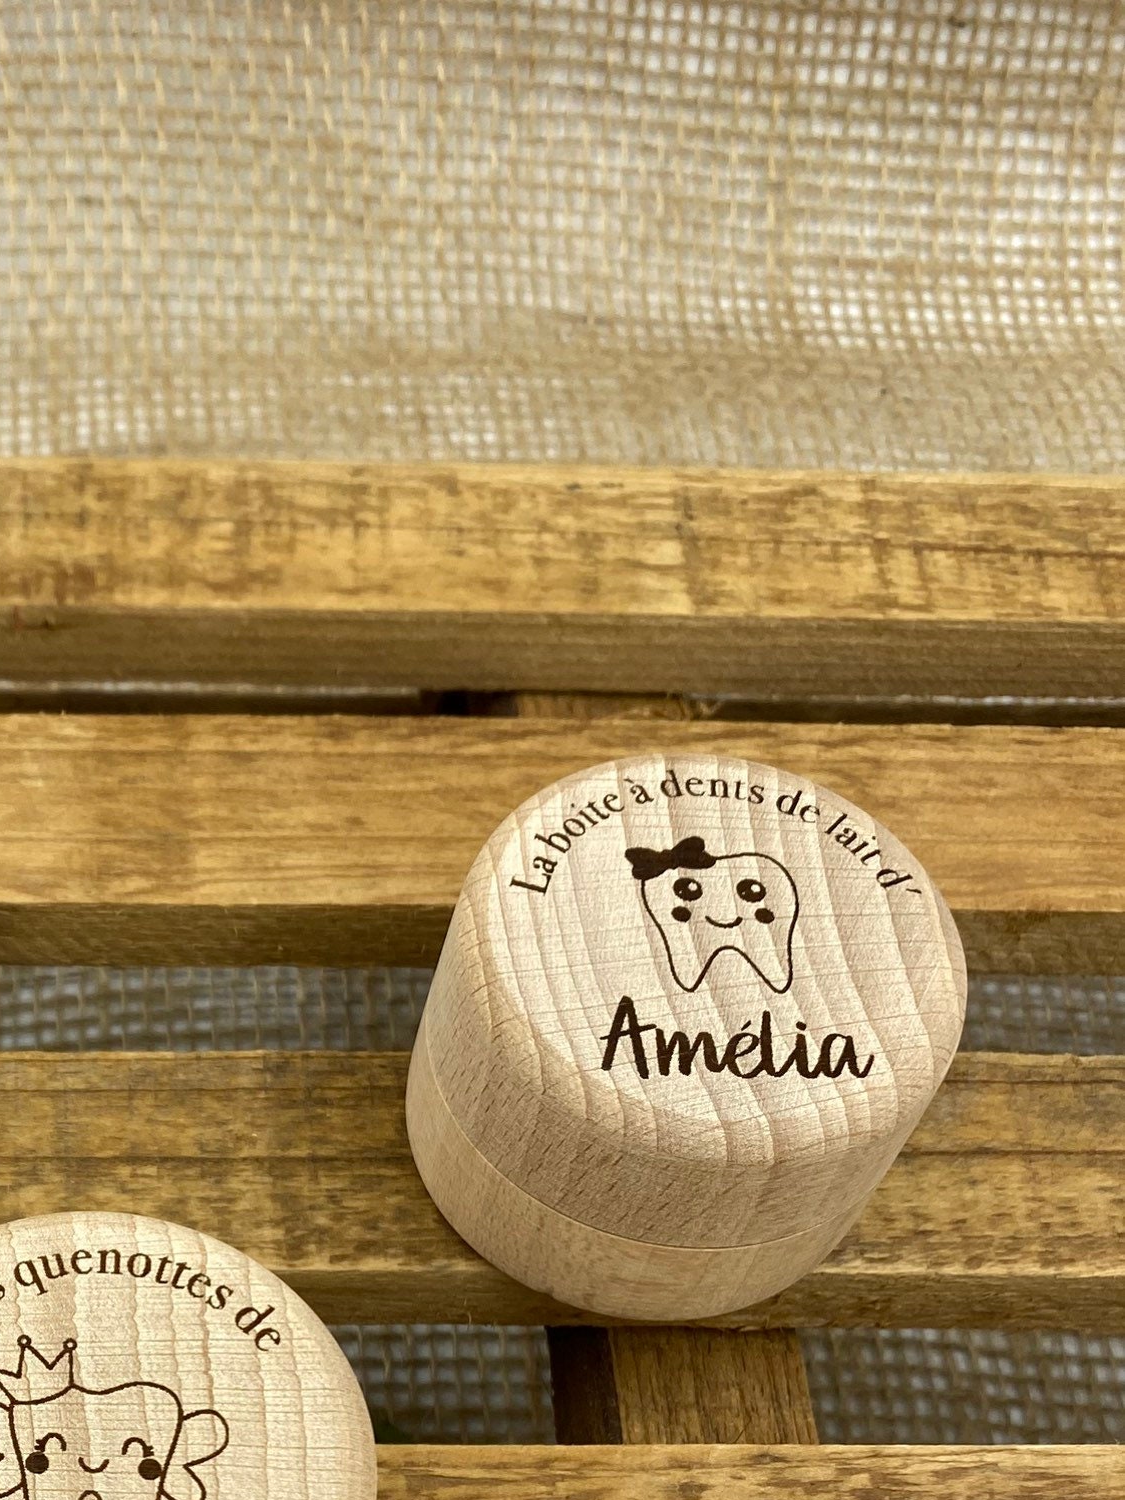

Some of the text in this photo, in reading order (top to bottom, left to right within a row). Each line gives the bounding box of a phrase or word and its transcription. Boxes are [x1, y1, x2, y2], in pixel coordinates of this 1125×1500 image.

[510, 853, 557, 897] La
[534, 793, 625, 855] boite
[624, 777, 654, 804] à
[660, 769, 764, 804] dents
[775, 789, 821, 824] de
[823, 813, 881, 866] lait
[600, 995, 874, 1079] Amélia
[13, 1248, 234, 1310] quenottes
[234, 1304, 282, 1352] de
